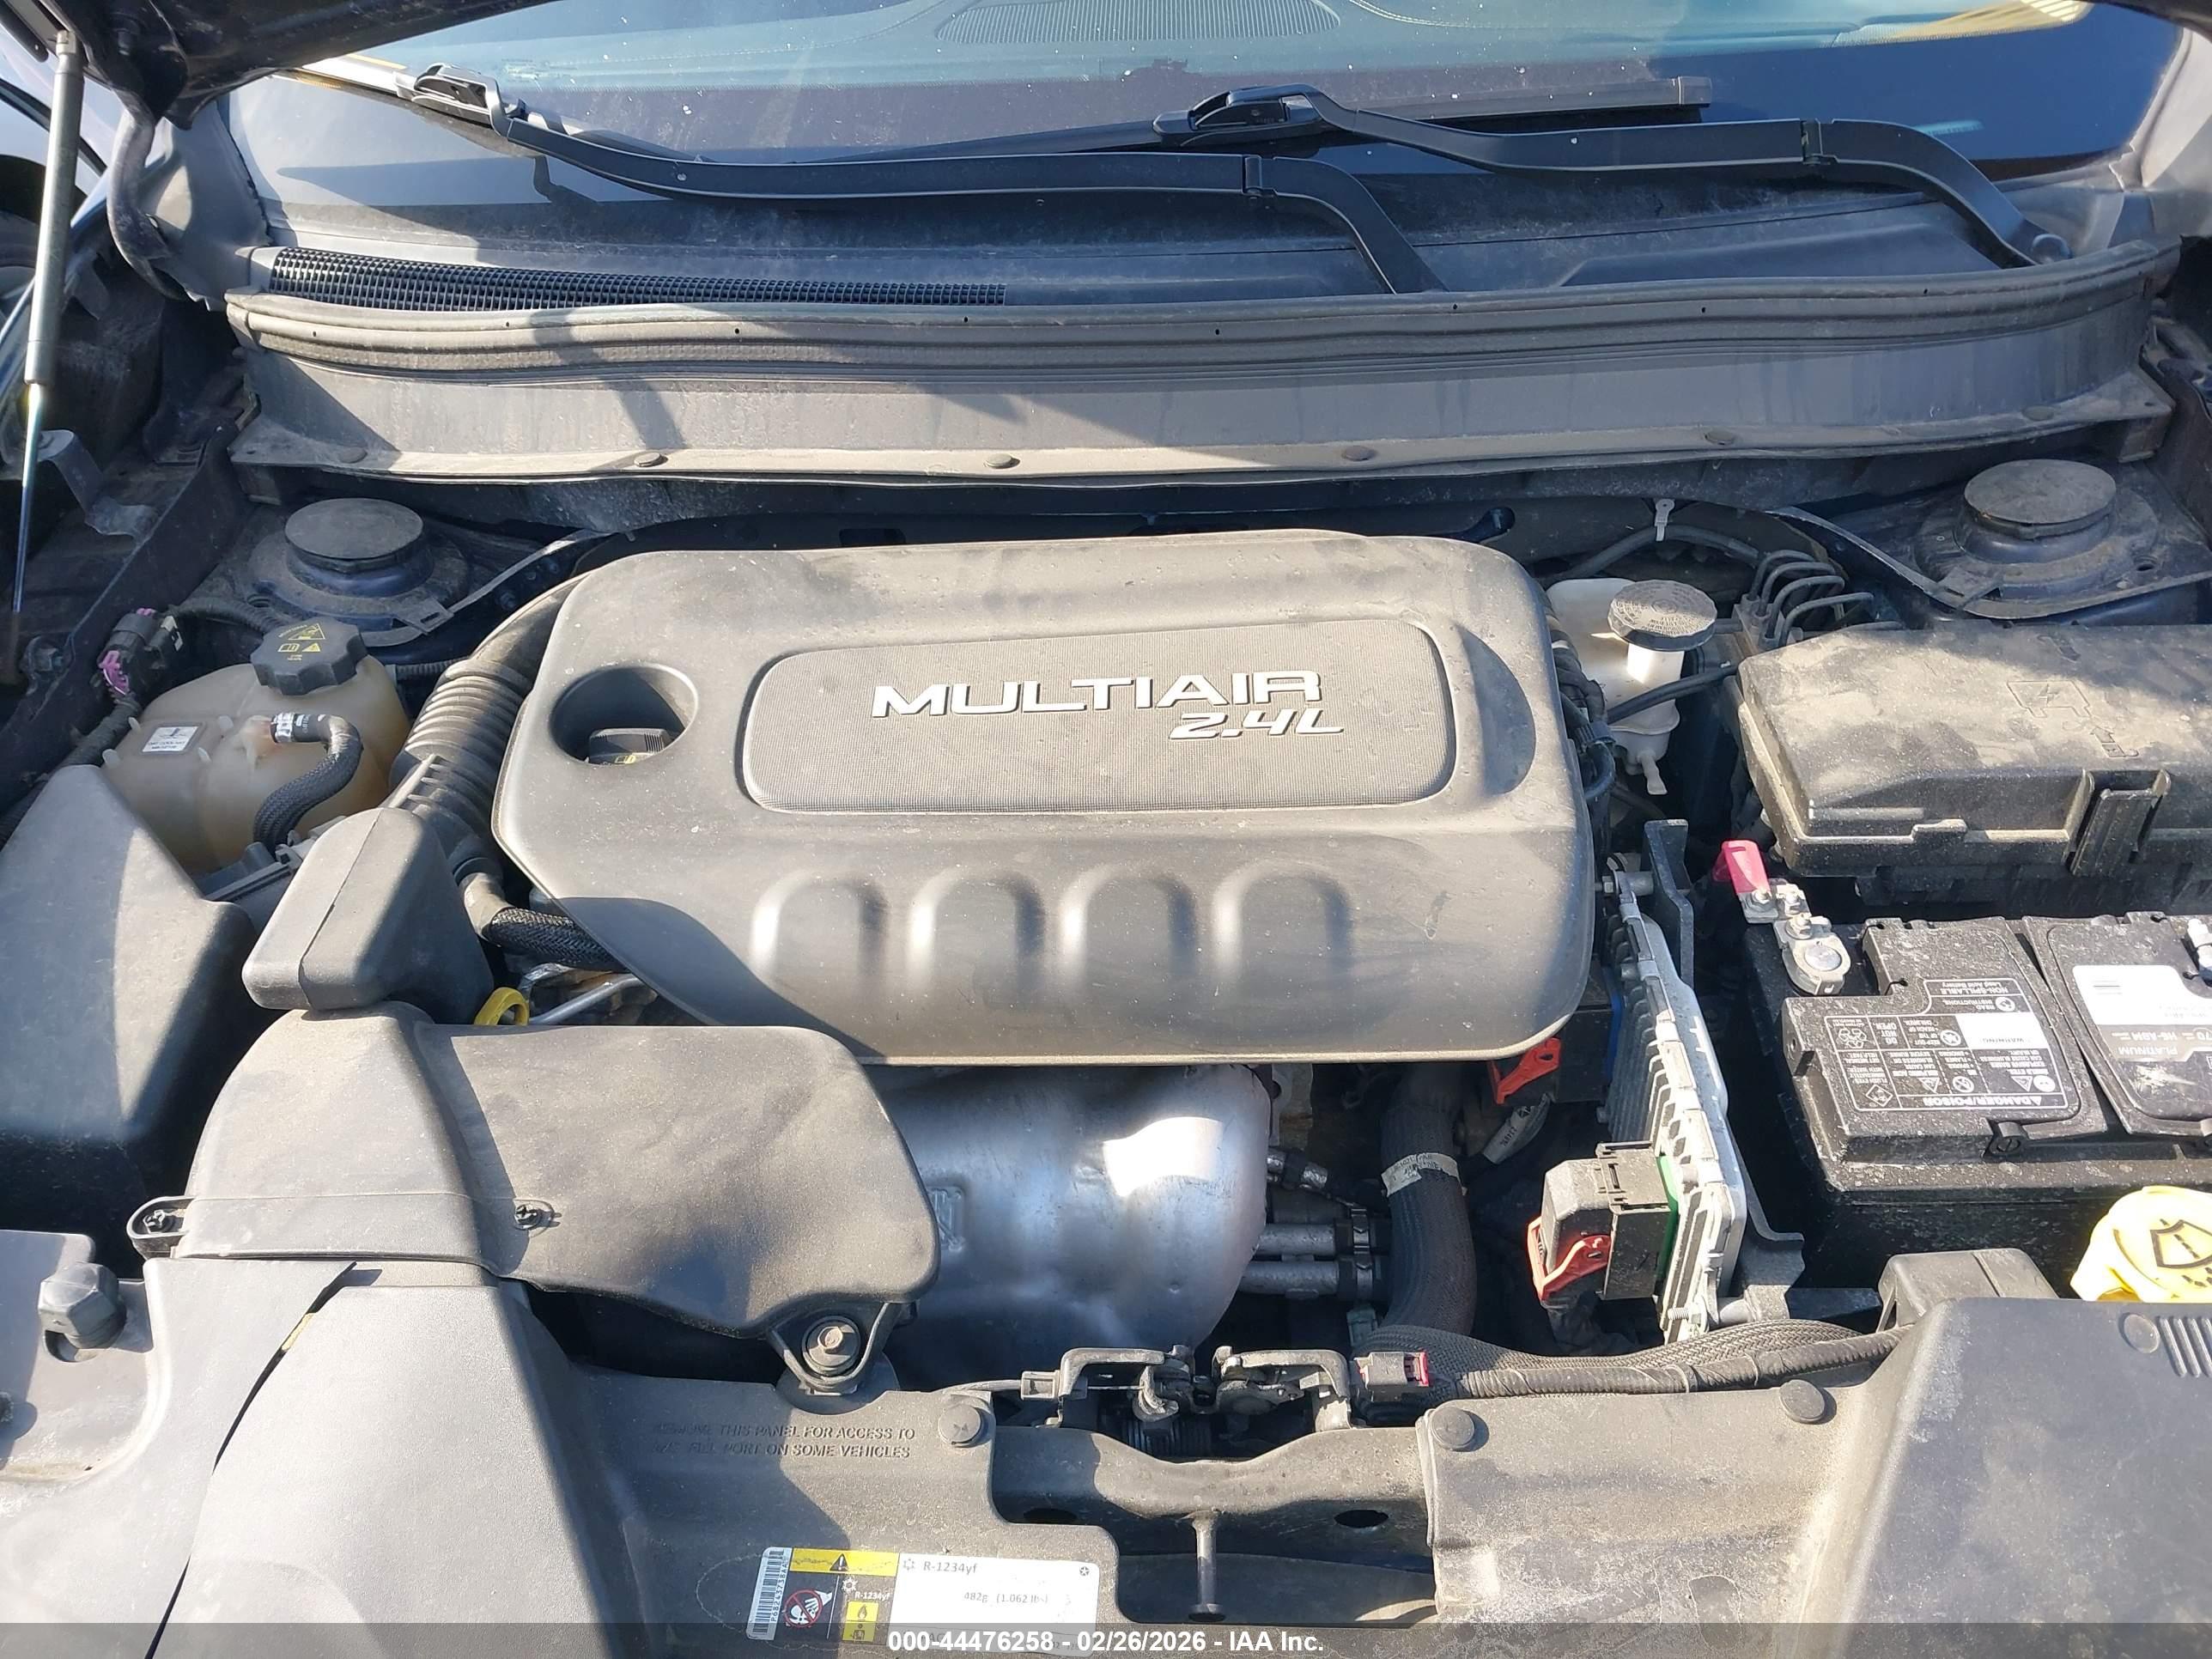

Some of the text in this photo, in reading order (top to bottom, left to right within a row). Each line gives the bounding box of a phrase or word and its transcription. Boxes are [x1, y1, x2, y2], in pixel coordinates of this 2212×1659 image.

[872, 669, 1322, 718] MULTIAIR
[1169, 707, 1345, 740] 2.4L
[2118, 1046, 2179, 1055] PLATINUM
[1923, 1096, 2033, 1107] DANGER/POISON
[720, 1424, 752, 1437] THIS
[755, 1425, 800, 1437] PANEL
[804, 1425, 833, 1438] FOR
[836, 1426, 893, 1440] ACCESS
[897, 1427, 915, 1440] TO
[688, 1442, 716, 1455] FILL
[722, 1442, 763, 1455] PORT
[766, 1443, 789, 1456] ON
[792, 1444, 836, 1457] SOME
[839, 1444, 911, 1459] VEHICLES
[922, 1559, 978, 1575] R-1234yf
[854, 1590, 890, 1601] R-1234yf
[963, 1591, 988, 1604] 482g
[996, 1593, 1028, 1604] (1.062
